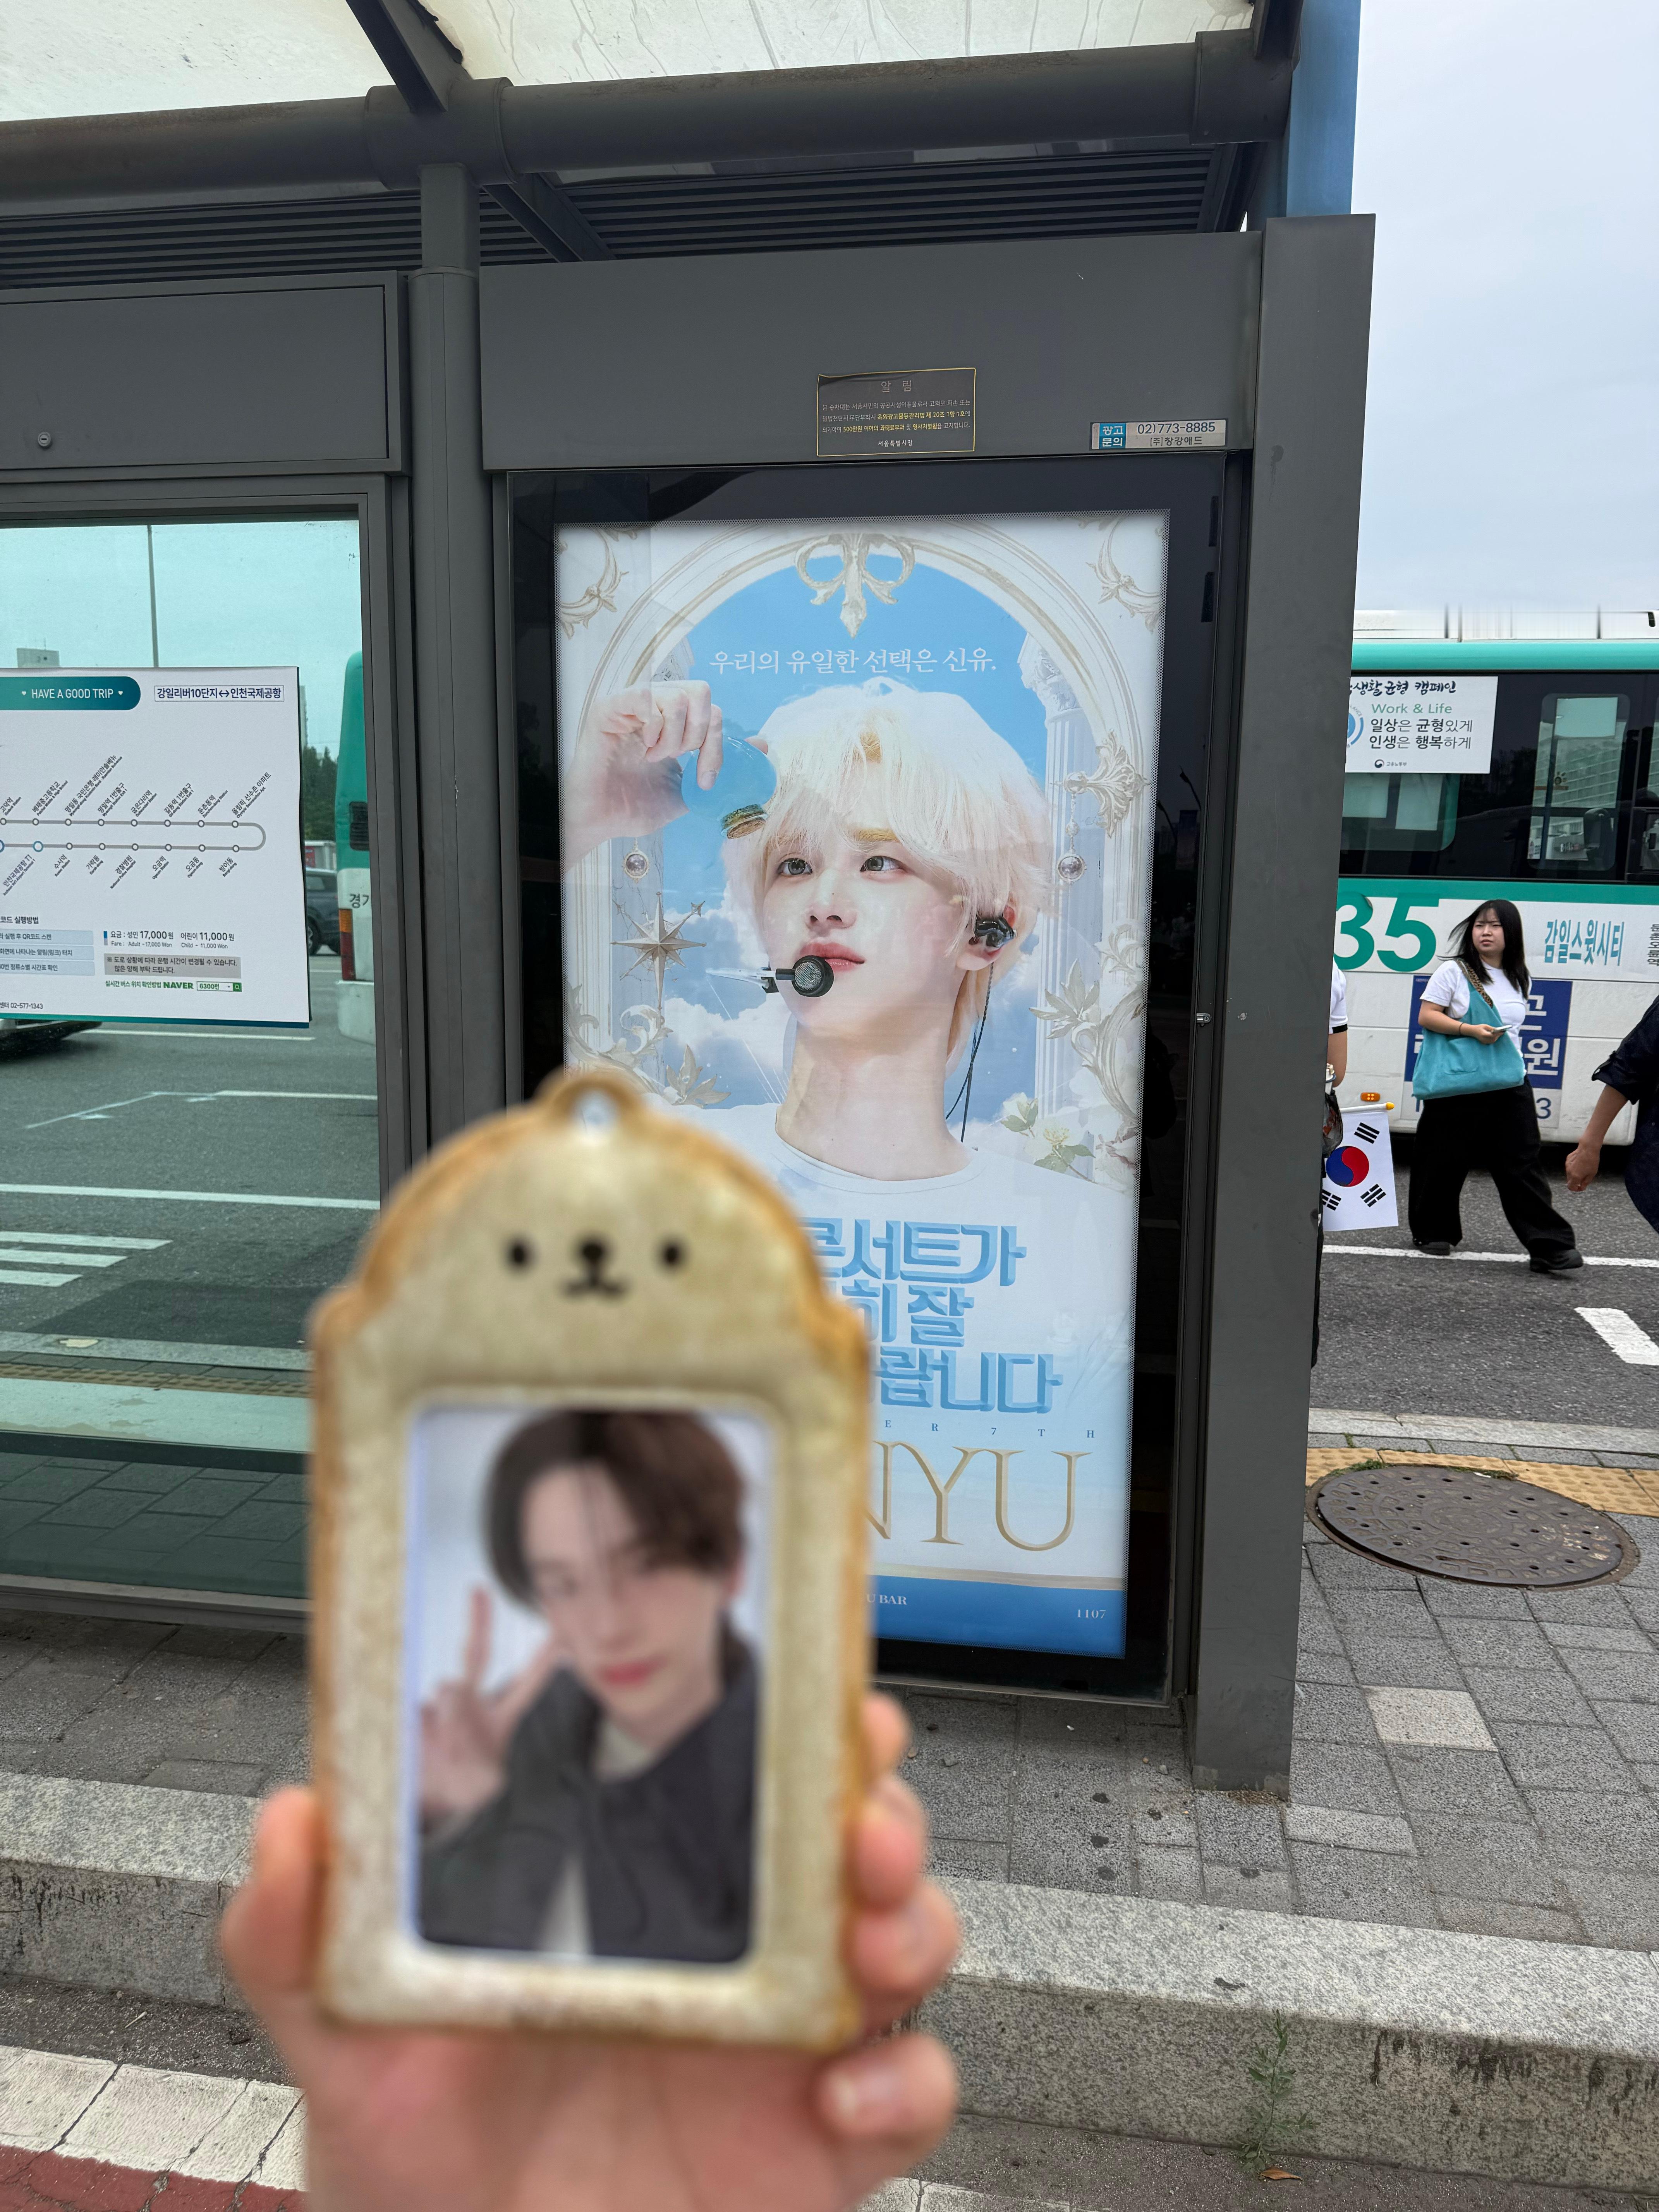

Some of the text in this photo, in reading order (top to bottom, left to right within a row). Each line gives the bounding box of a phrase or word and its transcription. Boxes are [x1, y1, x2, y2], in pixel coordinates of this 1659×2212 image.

[1103, 425, 1123, 435] 광고
[1137, 422, 1215, 434] 02)773-8885
[1102, 437, 1123, 447] 문의
[709, 647, 996, 675] 우리의 유일한 선택은 신유.
[32, 689, 113, 699] HAVE A GOOD TRIP
[1384, 680, 1409, 695] 균형
[1415, 680, 1456, 695] 캠페인
[1371, 703, 1452, 714] Work & Life
[1371, 719, 1473, 732] 일상은 균형있게
[1369, 736, 1472, 749] 인생은 행복하게
[232, 772, 271, 815] 올림픽 선수촌 아파트
[64, 798, 78, 812] 명일동
[98, 798, 112, 813] 명일역
[164, 798, 179, 814] 길동역
[198, 795, 216, 814] 둔촌동역
[54, 854, 67, 869] 수서역
[86, 855, 100, 869] 가락동
[115, 855, 133, 874] 경찰병원
[153, 855, 166, 871] 오금역
[186, 857, 199, 872] 오금동
[219, 857, 233, 872] 방이동
[3, 860, 27, 887] 인천국제공항
[1544, 919, 1624, 966] 감일스윗시티
[908, 1284, 975, 1348] 잘
[869, 1345, 1064, 1414] 랍니다
[864, 1440, 1093, 1552] NYU
[879, 1594, 907, 1605] BAR
[1078, 1609, 1106, 1619] 1107
